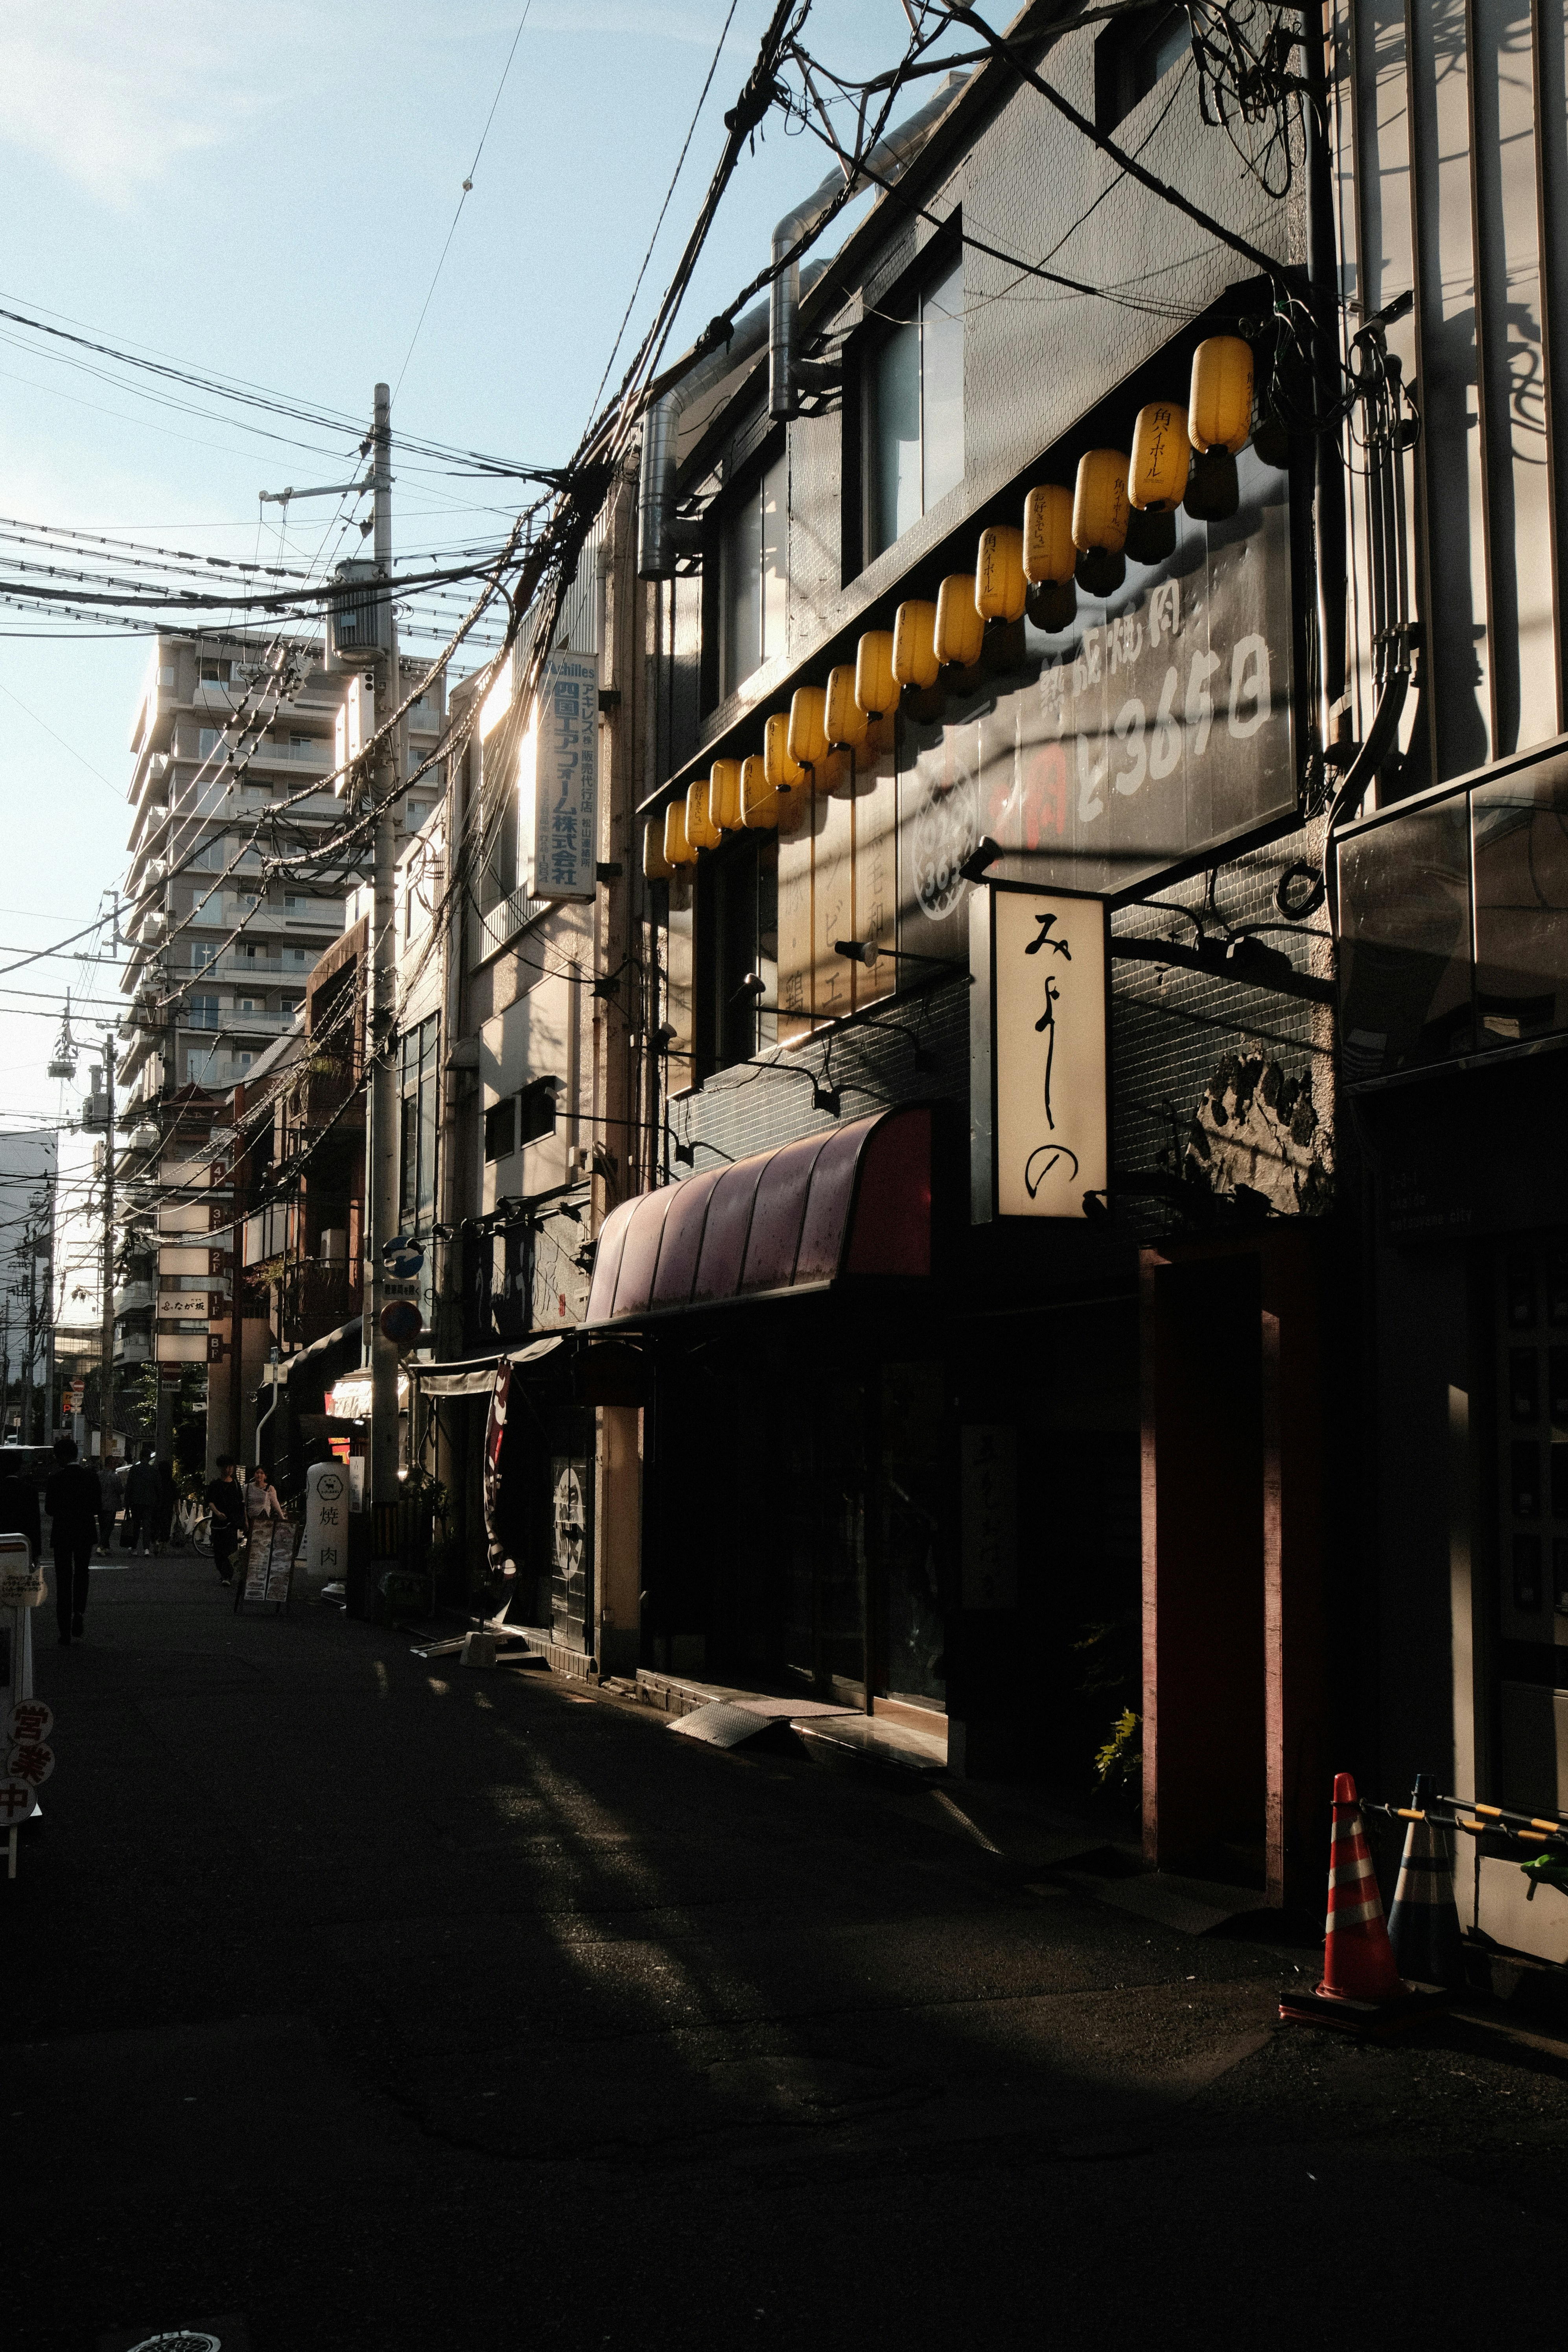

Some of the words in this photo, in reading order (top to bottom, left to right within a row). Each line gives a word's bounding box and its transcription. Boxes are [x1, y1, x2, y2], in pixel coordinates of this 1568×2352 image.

[1150, 408, 1171, 477] 角ハイボール
[1112, 477, 1124, 527] 角ハイボール
[983, 533, 996, 594] 角ハイボール
[542, 660, 595, 678] Achilles
[551, 681, 580, 885] 四国エアフォーム株式会社
[1024, 913, 1079, 1199] みよしの
[320, 1507, 339, 1566] 焼肉
[0, 1705, 52, 1817] 営業中
